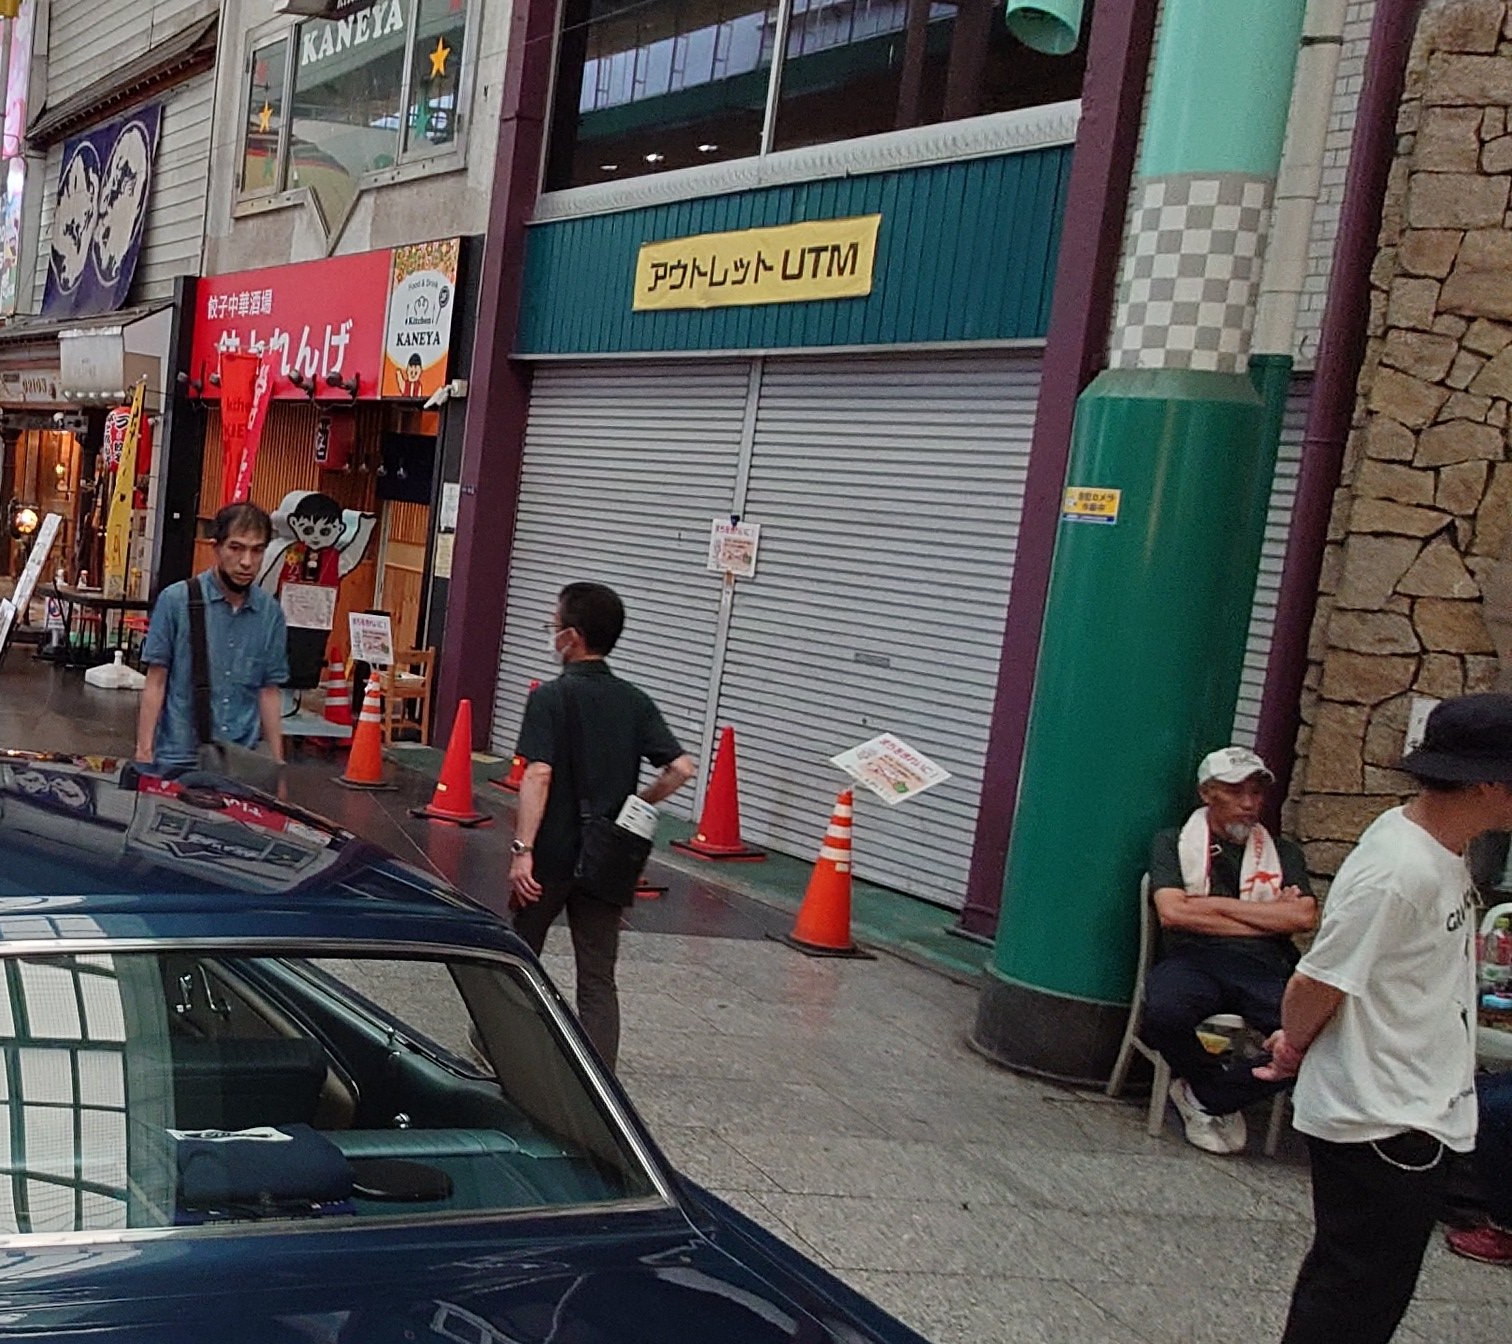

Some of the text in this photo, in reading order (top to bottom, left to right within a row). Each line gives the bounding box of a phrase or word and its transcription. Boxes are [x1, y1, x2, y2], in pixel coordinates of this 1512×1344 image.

[648, 242, 859, 292] アウトレット UTM
[207, 289, 273, 320] 餃子中華酒場
[409, 316, 431, 326] Kitchen
[396, 331, 441, 347] KANEYA
